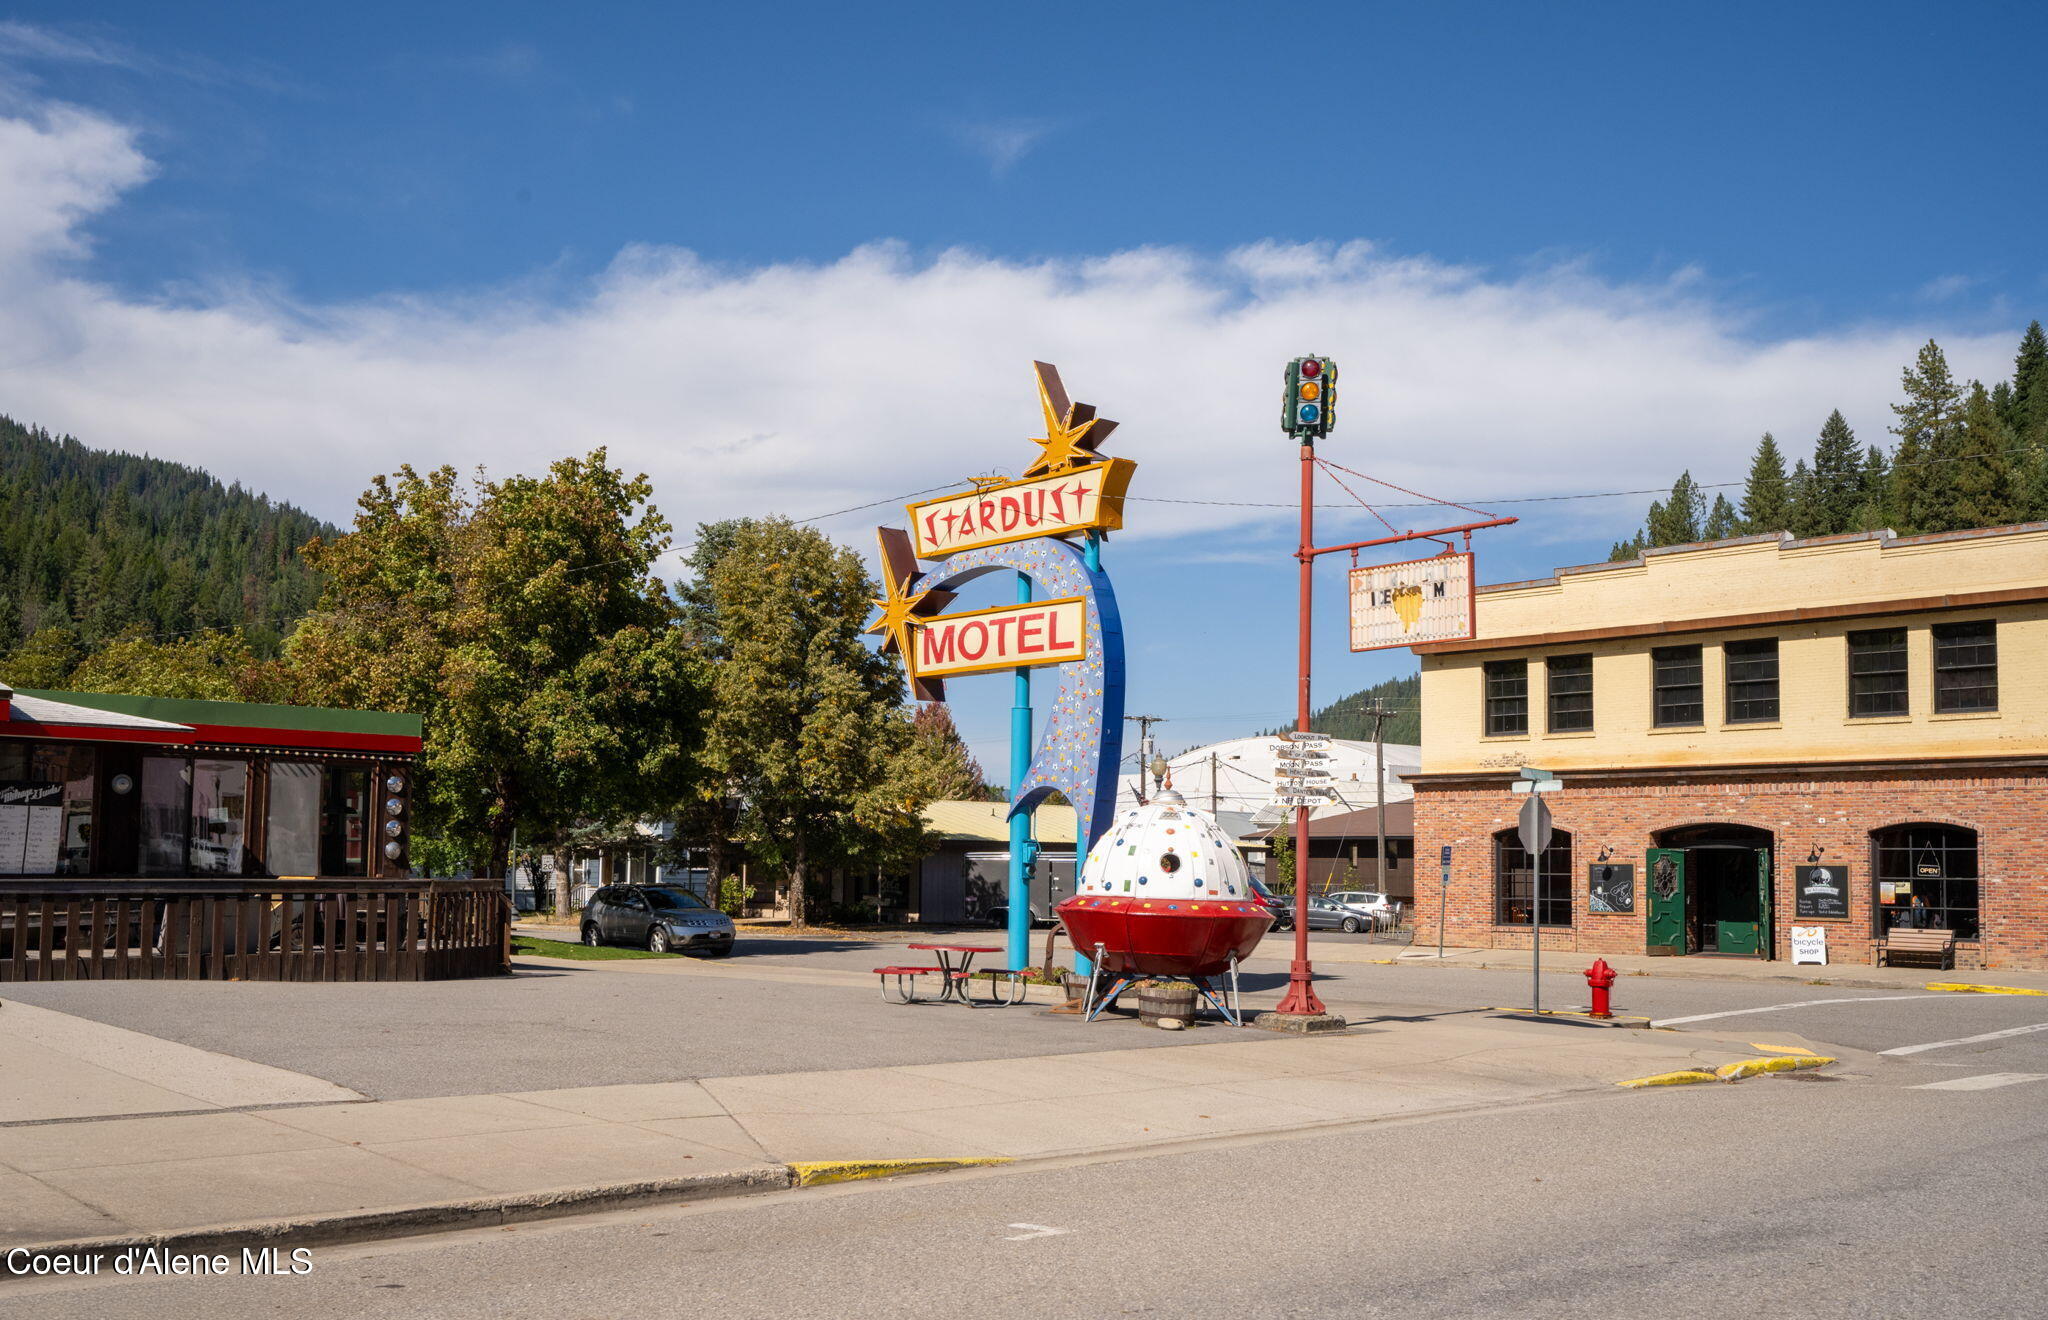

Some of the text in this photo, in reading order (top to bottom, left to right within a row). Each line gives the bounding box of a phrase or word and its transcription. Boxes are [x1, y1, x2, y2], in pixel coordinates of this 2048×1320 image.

[923, 479, 1094, 548] STARDUST
[923, 610, 1075, 665] MOTEL
[1269, 744, 1300, 752] DOBSON
[1793, 938, 1824, 947] bicycle
